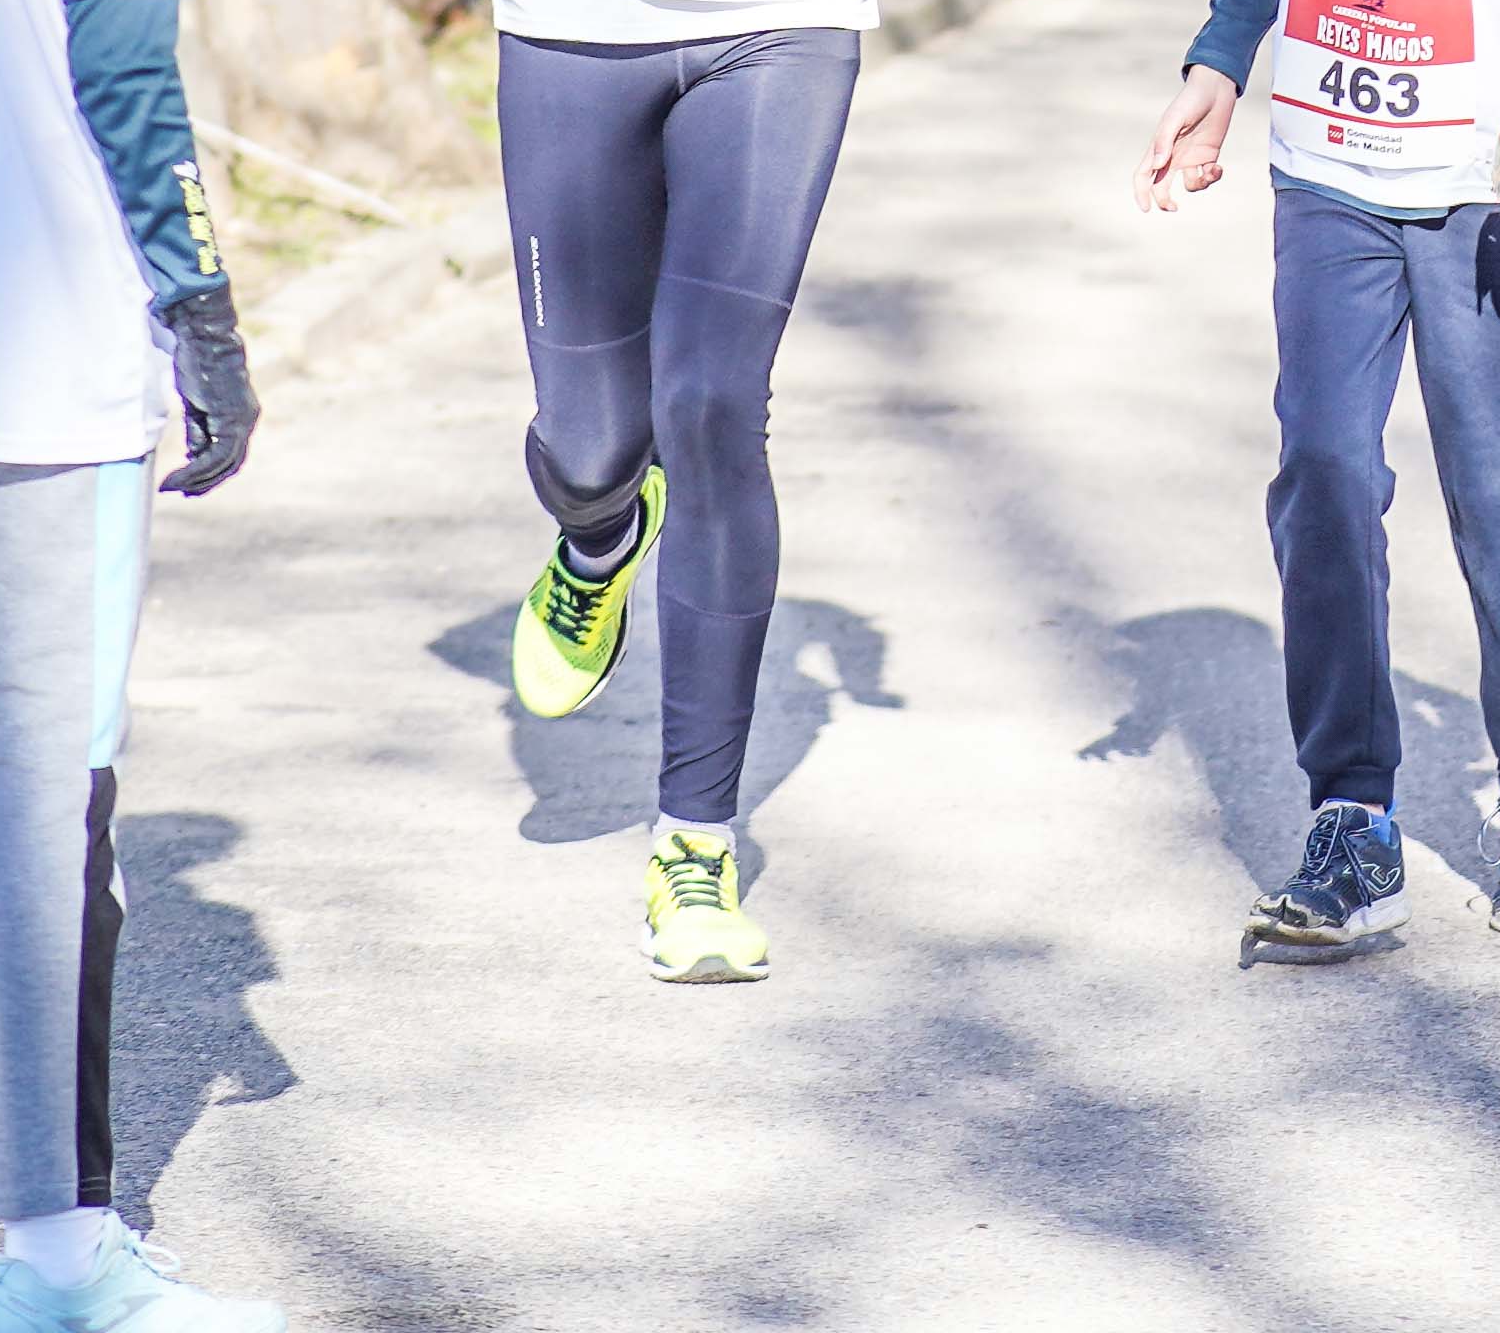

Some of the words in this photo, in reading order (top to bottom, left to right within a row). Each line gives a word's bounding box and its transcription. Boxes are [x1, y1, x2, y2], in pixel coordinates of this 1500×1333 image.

[1316, 15, 1361, 55] REYES
[1366, 31, 1435, 62] MAGOS
[1319, 60, 1420, 118] 463
[1346, 128, 1403, 143] Comunidad
[1363, 142, 1403, 154] Madrid
